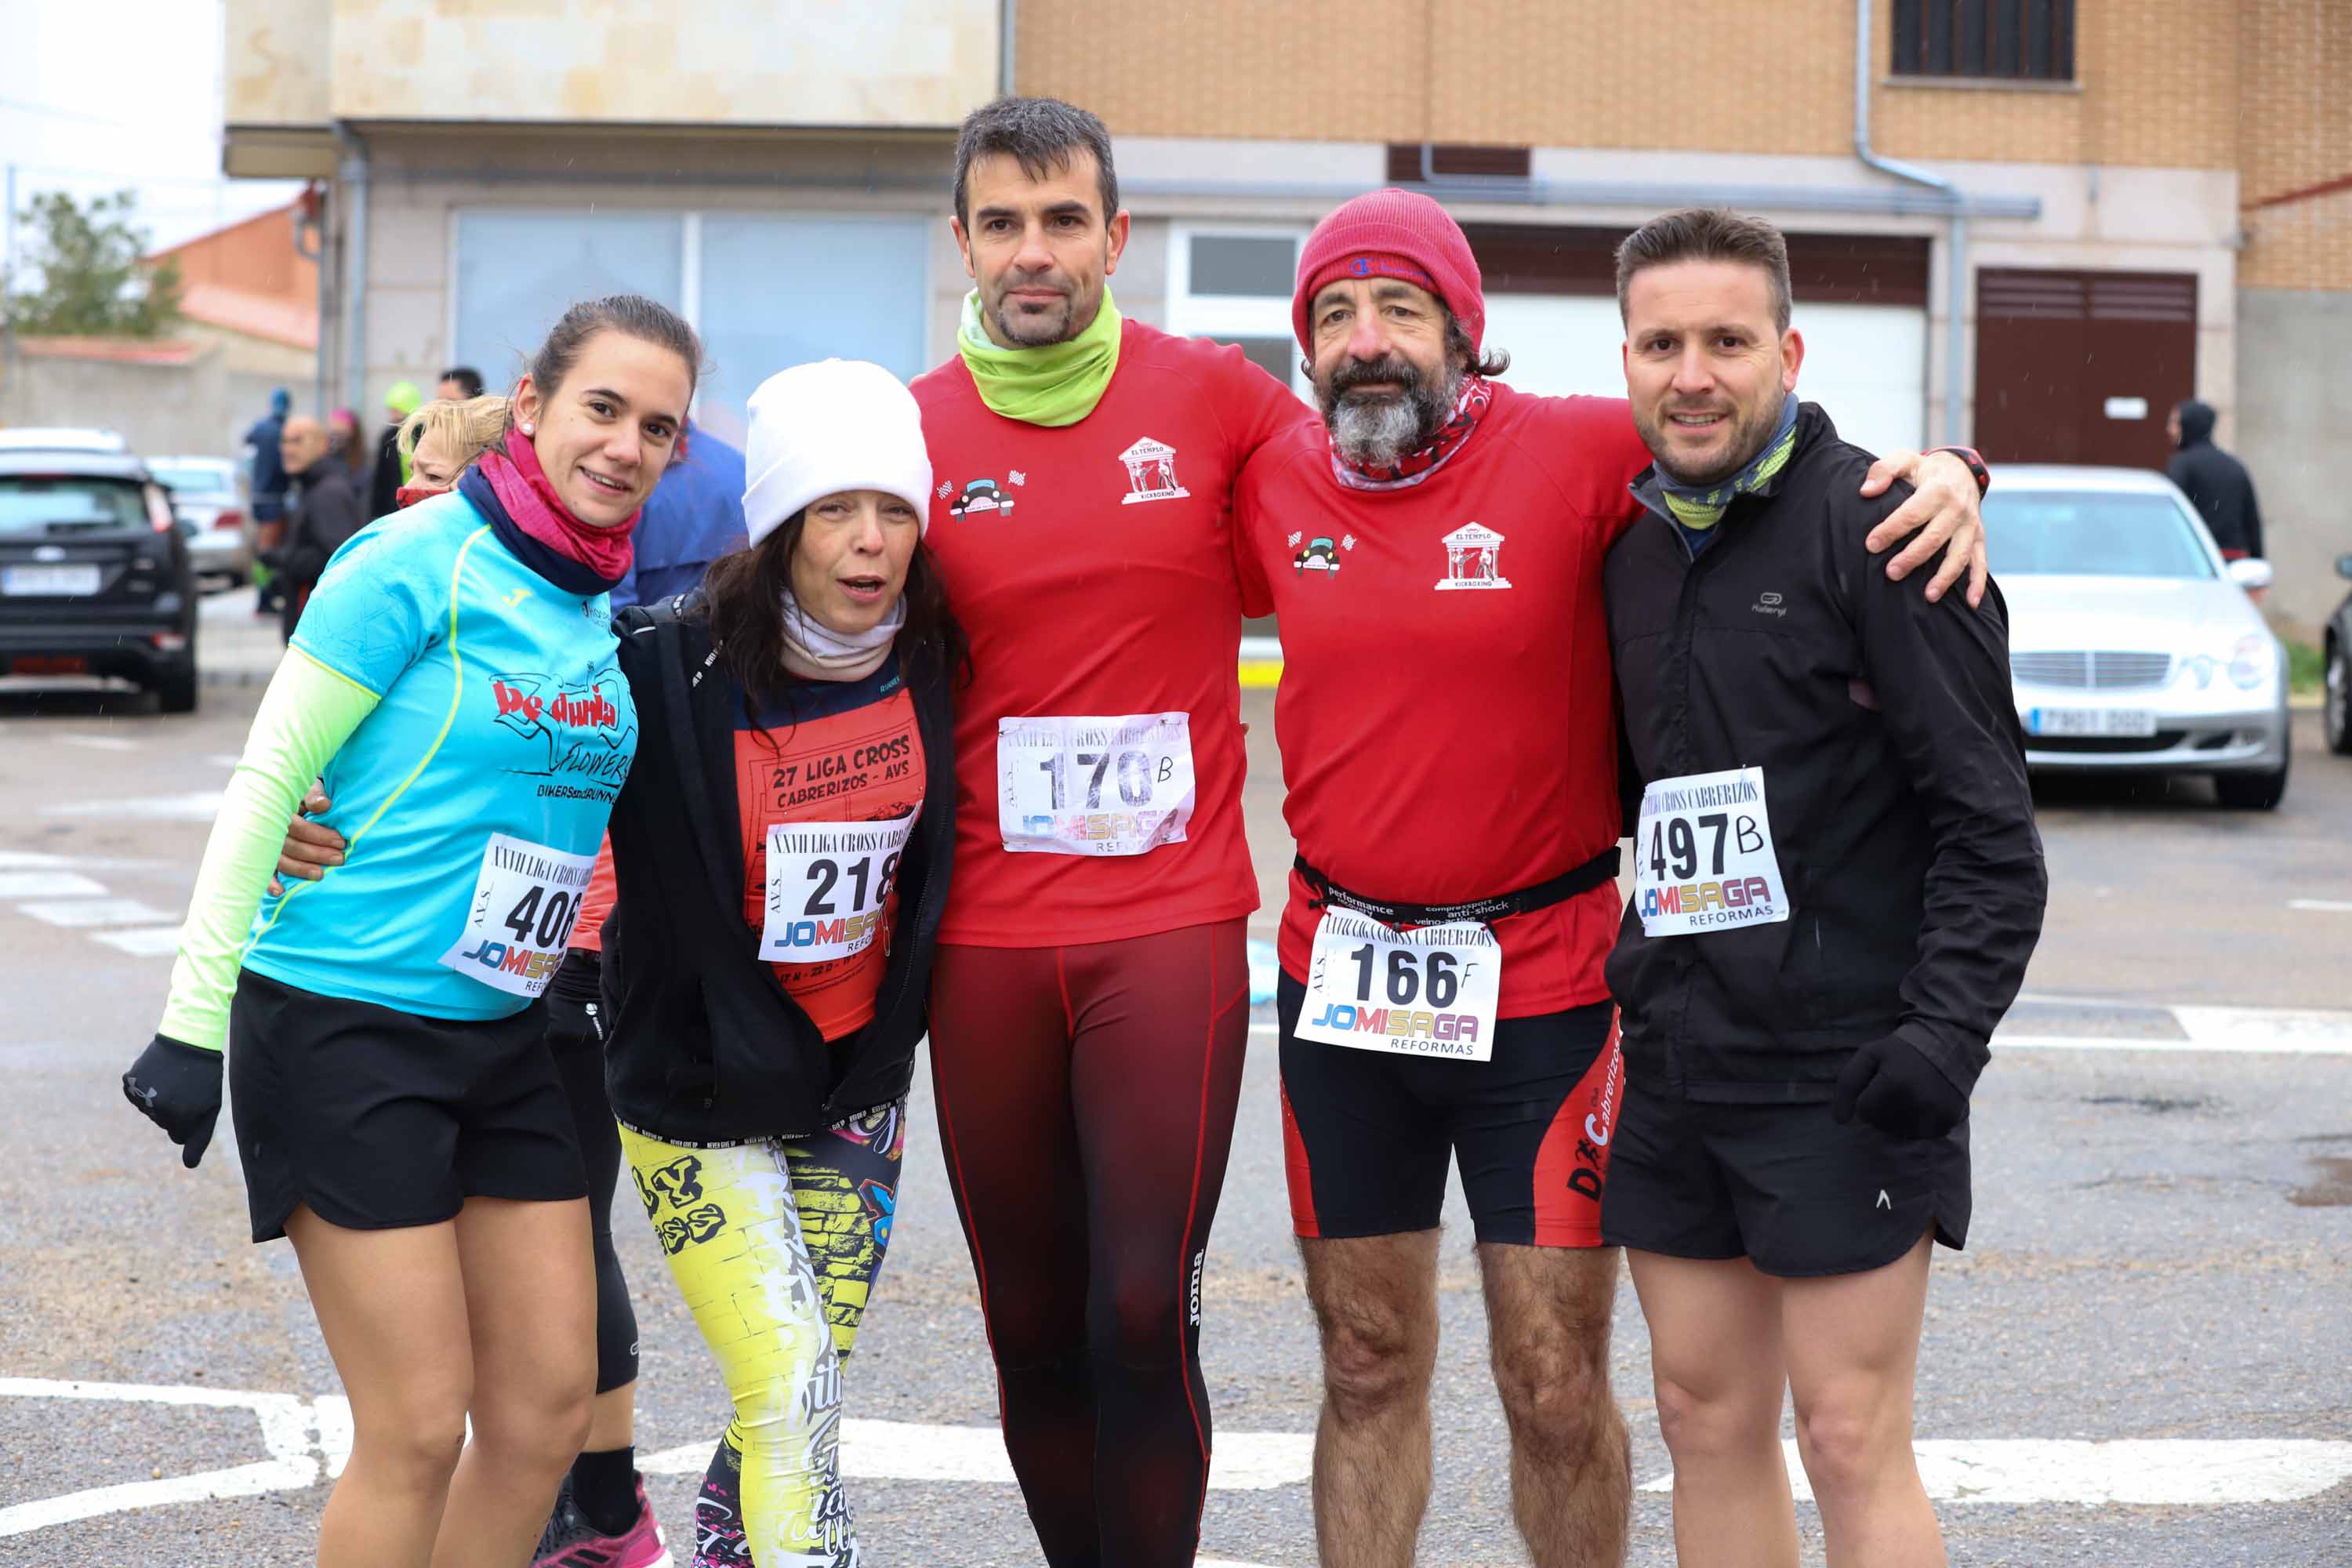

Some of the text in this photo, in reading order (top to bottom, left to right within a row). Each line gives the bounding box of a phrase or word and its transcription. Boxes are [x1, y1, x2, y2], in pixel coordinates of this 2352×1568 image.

[773, 735, 910, 789] 27 LIGA CROSS
[1158, 757, 1174, 783] B
[777, 773, 868, 808] CABRERIZOS
[885, 760, 909, 780] AVS
[1040, 751, 1153, 810] 170
[1661, 789, 1686, 813] CROSS
[1688, 780, 1759, 810] CABRERIZOS
[774, 834, 808, 853] XXVII
[812, 833, 837, 853] LIGA
[841, 833, 877, 852] CROSS
[1651, 813, 1729, 881] 497
[1736, 815, 1764, 855] B
[804, 852, 900, 916] 218
[1329, 887, 1394, 915] performance
[1642, 877, 1772, 917] JOMISAGA
[1425, 899, 1494, 912] compressport
[1448, 901, 1509, 918] anti-shock
[1690, 905, 1774, 927] REFORMAS
[1353, 919, 1375, 940] LIGA
[1377, 926, 1412, 946] CROSS
[1415, 928, 1492, 948] CABRERIZOS
[1351, 943, 1458, 1008] 166
[1461, 963, 1479, 989] F
[1312, 1003, 1479, 1043] JOMISAGA
[1391, 1038, 1474, 1055] REFORMAS
[1584, 1037, 1621, 1146] Cabrerizos
